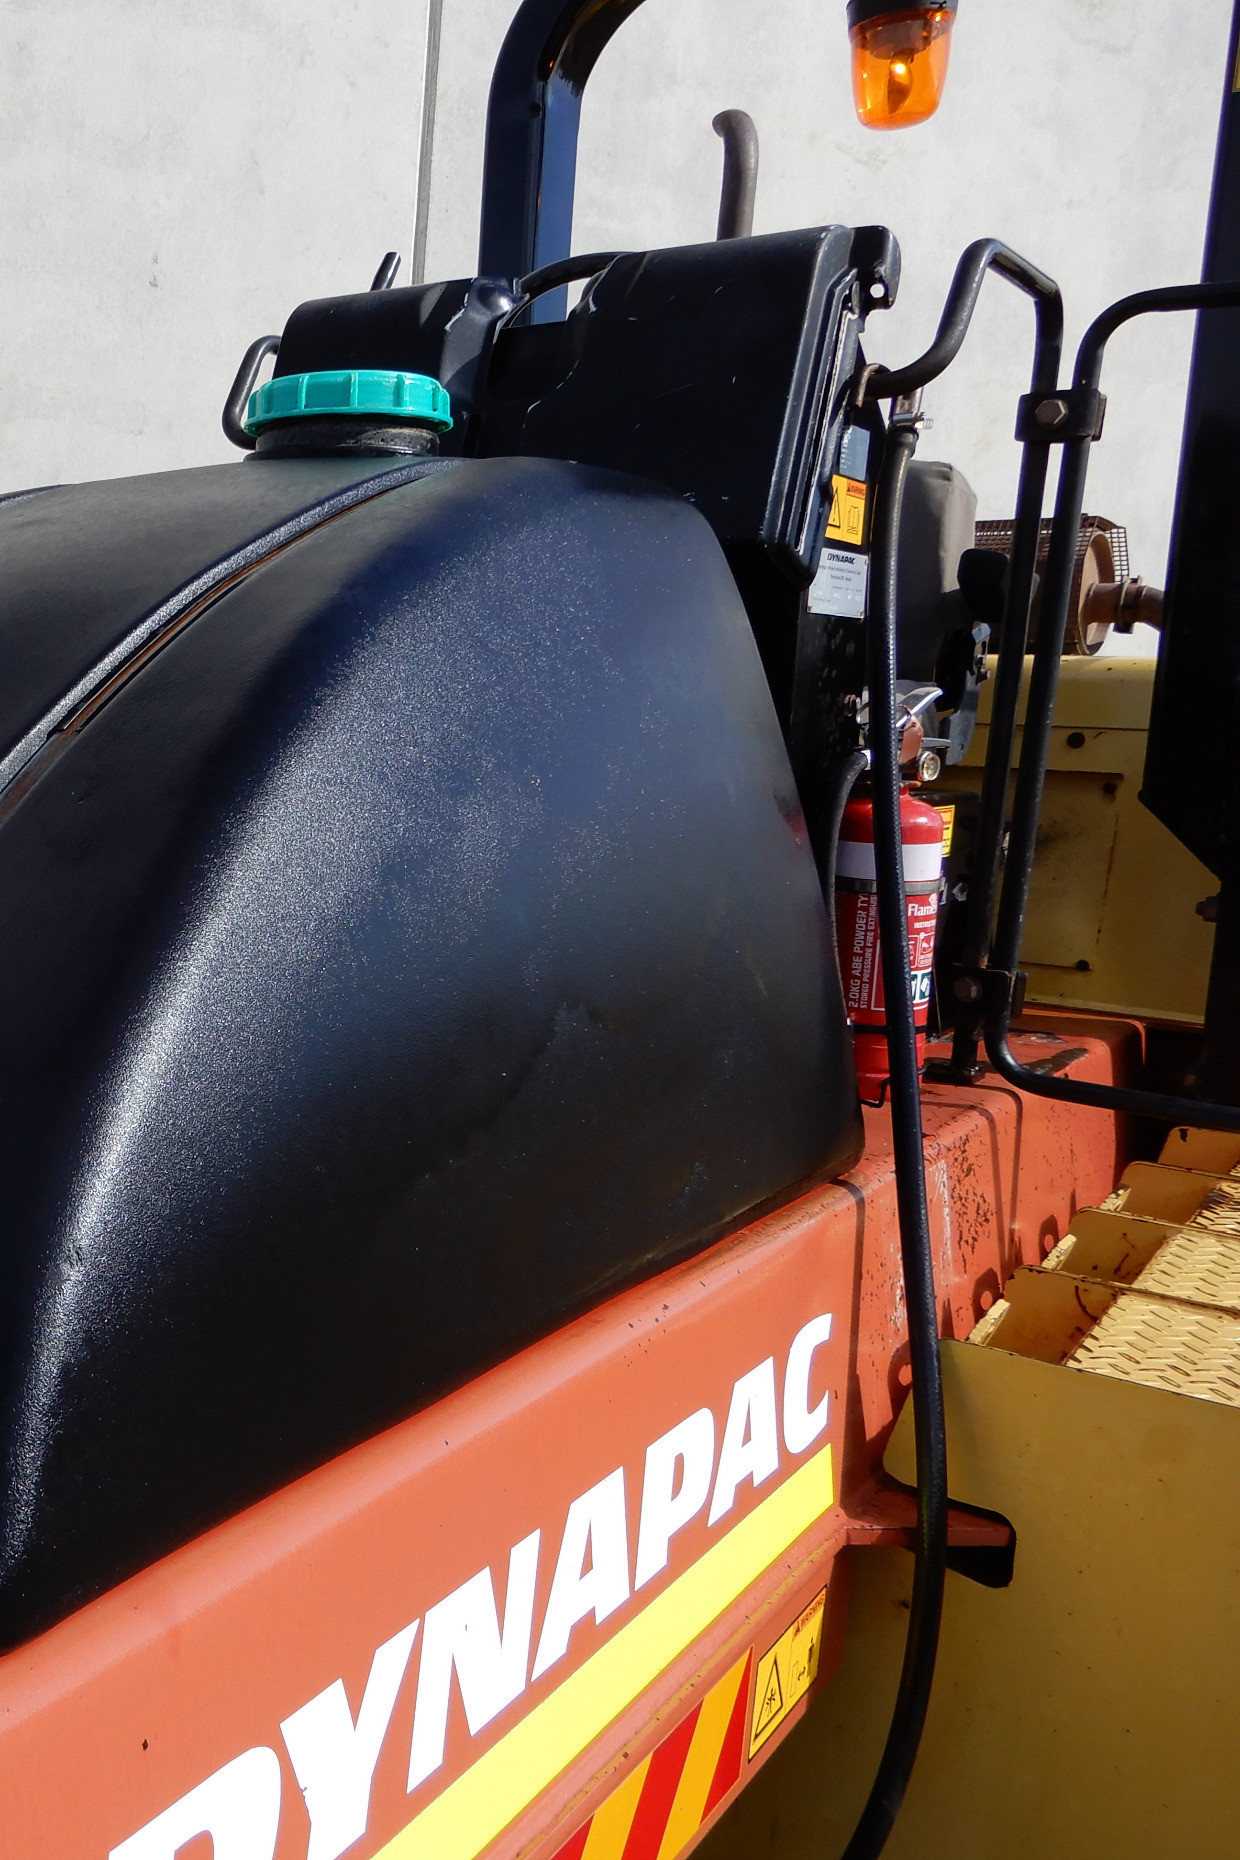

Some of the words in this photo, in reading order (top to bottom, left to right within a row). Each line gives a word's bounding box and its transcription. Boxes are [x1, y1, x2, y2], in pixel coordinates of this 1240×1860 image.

[826, 552, 856, 565] DYNAPAC
[853, 910, 868, 954] POWDER
[866, 931, 875, 947] FIRE
[851, 956, 863, 977] ABE
[862, 947, 873, 983] PRESSURE
[848, 979, 861, 1008] 2.0KG
[860, 983, 870, 1009] STORED
